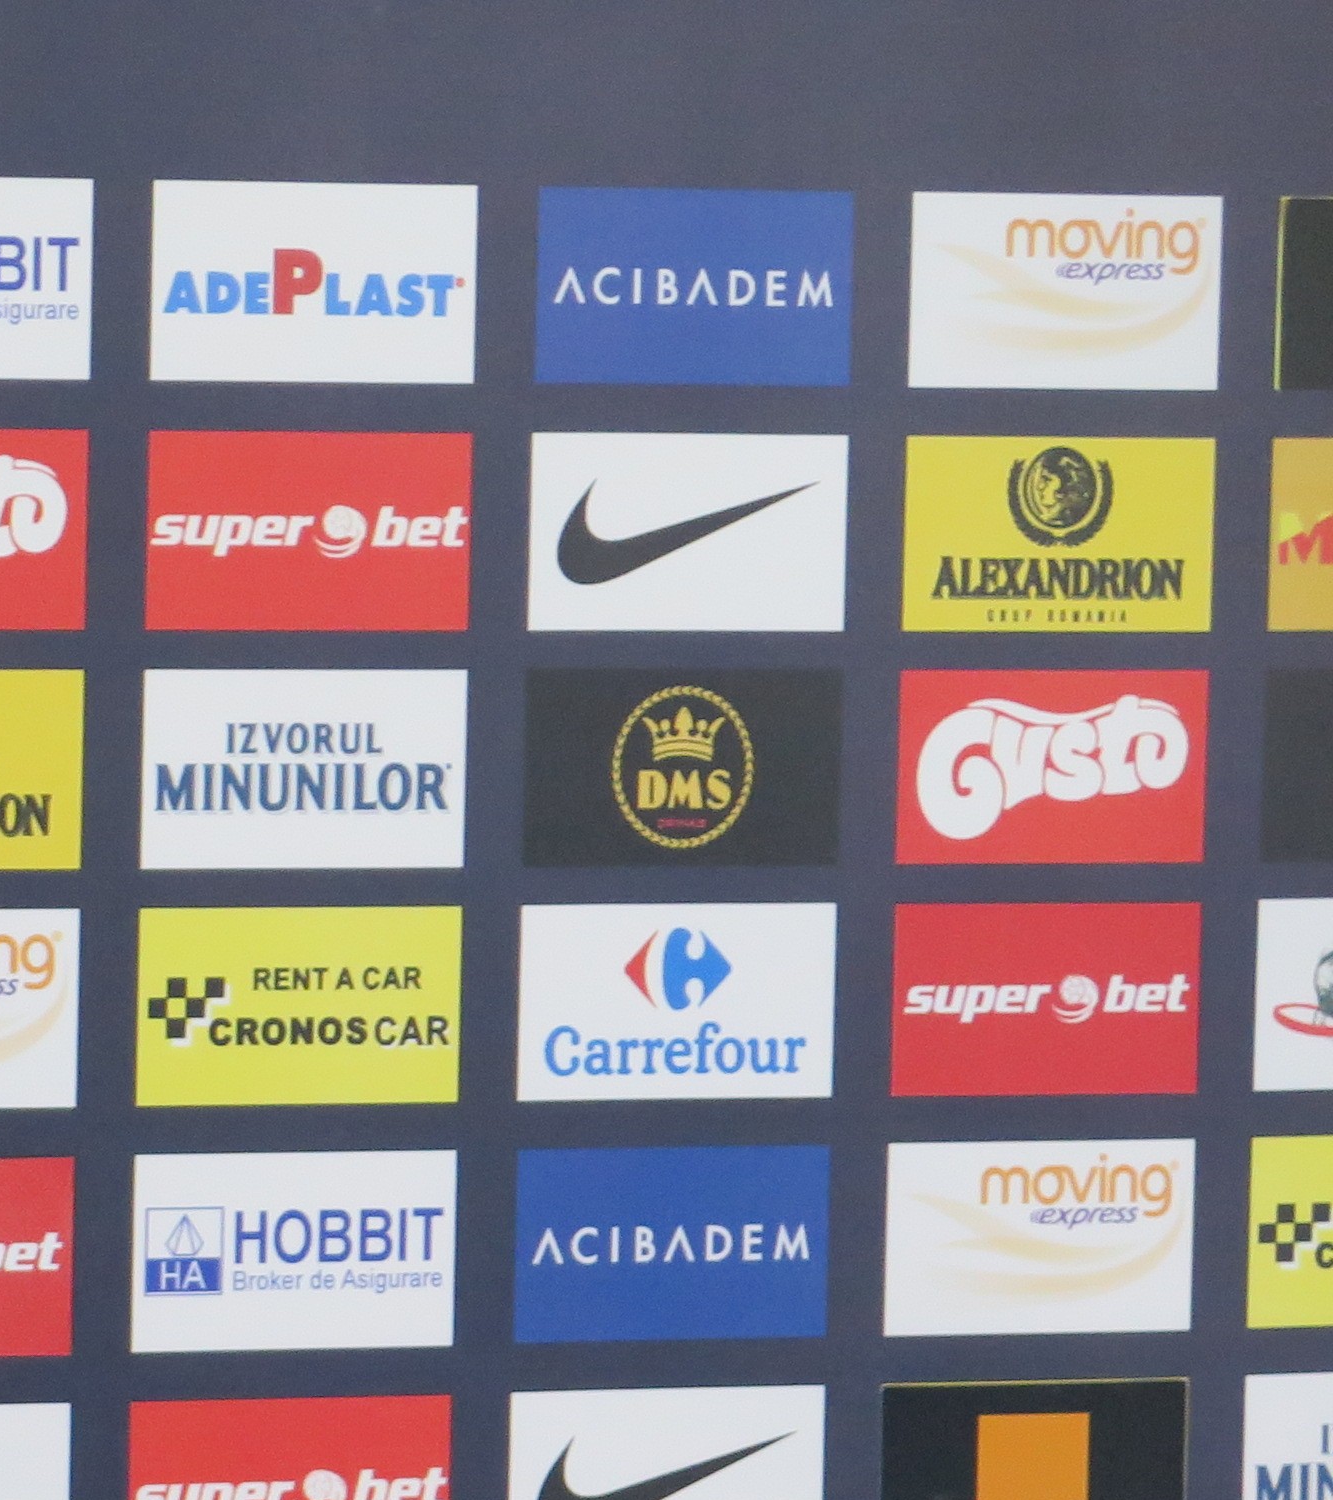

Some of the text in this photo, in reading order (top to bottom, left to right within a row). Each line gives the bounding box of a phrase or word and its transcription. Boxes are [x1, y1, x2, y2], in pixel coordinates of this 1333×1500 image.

[1006, 207, 1200, 277] moving
[163, 249, 454, 317] ADEPLAST
[554, 267, 833, 307] ACIBADEM
[1066, 258, 1164, 284] express
[150, 506, 469, 557] super bet
[932, 556, 1184, 600] ALEXANDRION
[226, 723, 382, 754] IZVORUL
[156, 763, 447, 811] MINUNILOR
[916, 695, 1189, 840] GUSTO
[637, 769, 731, 809] DMS
[254, 967, 421, 991] RENT A CAR
[904, 974, 1190, 1023] super bet
[206, 1014, 448, 1047] CRONOS CAR
[544, 1022, 806, 1077] Carrefour
[980, 1153, 1174, 1219] moving
[235, 1208, 443, 1264] HOBBIT
[1039, 1207, 1139, 1229] express
[532, 1224, 809, 1265] ACIBADEM
[160, 1261, 208, 1289] HA
[232, 1269, 443, 1295] Broker de Asigurare
